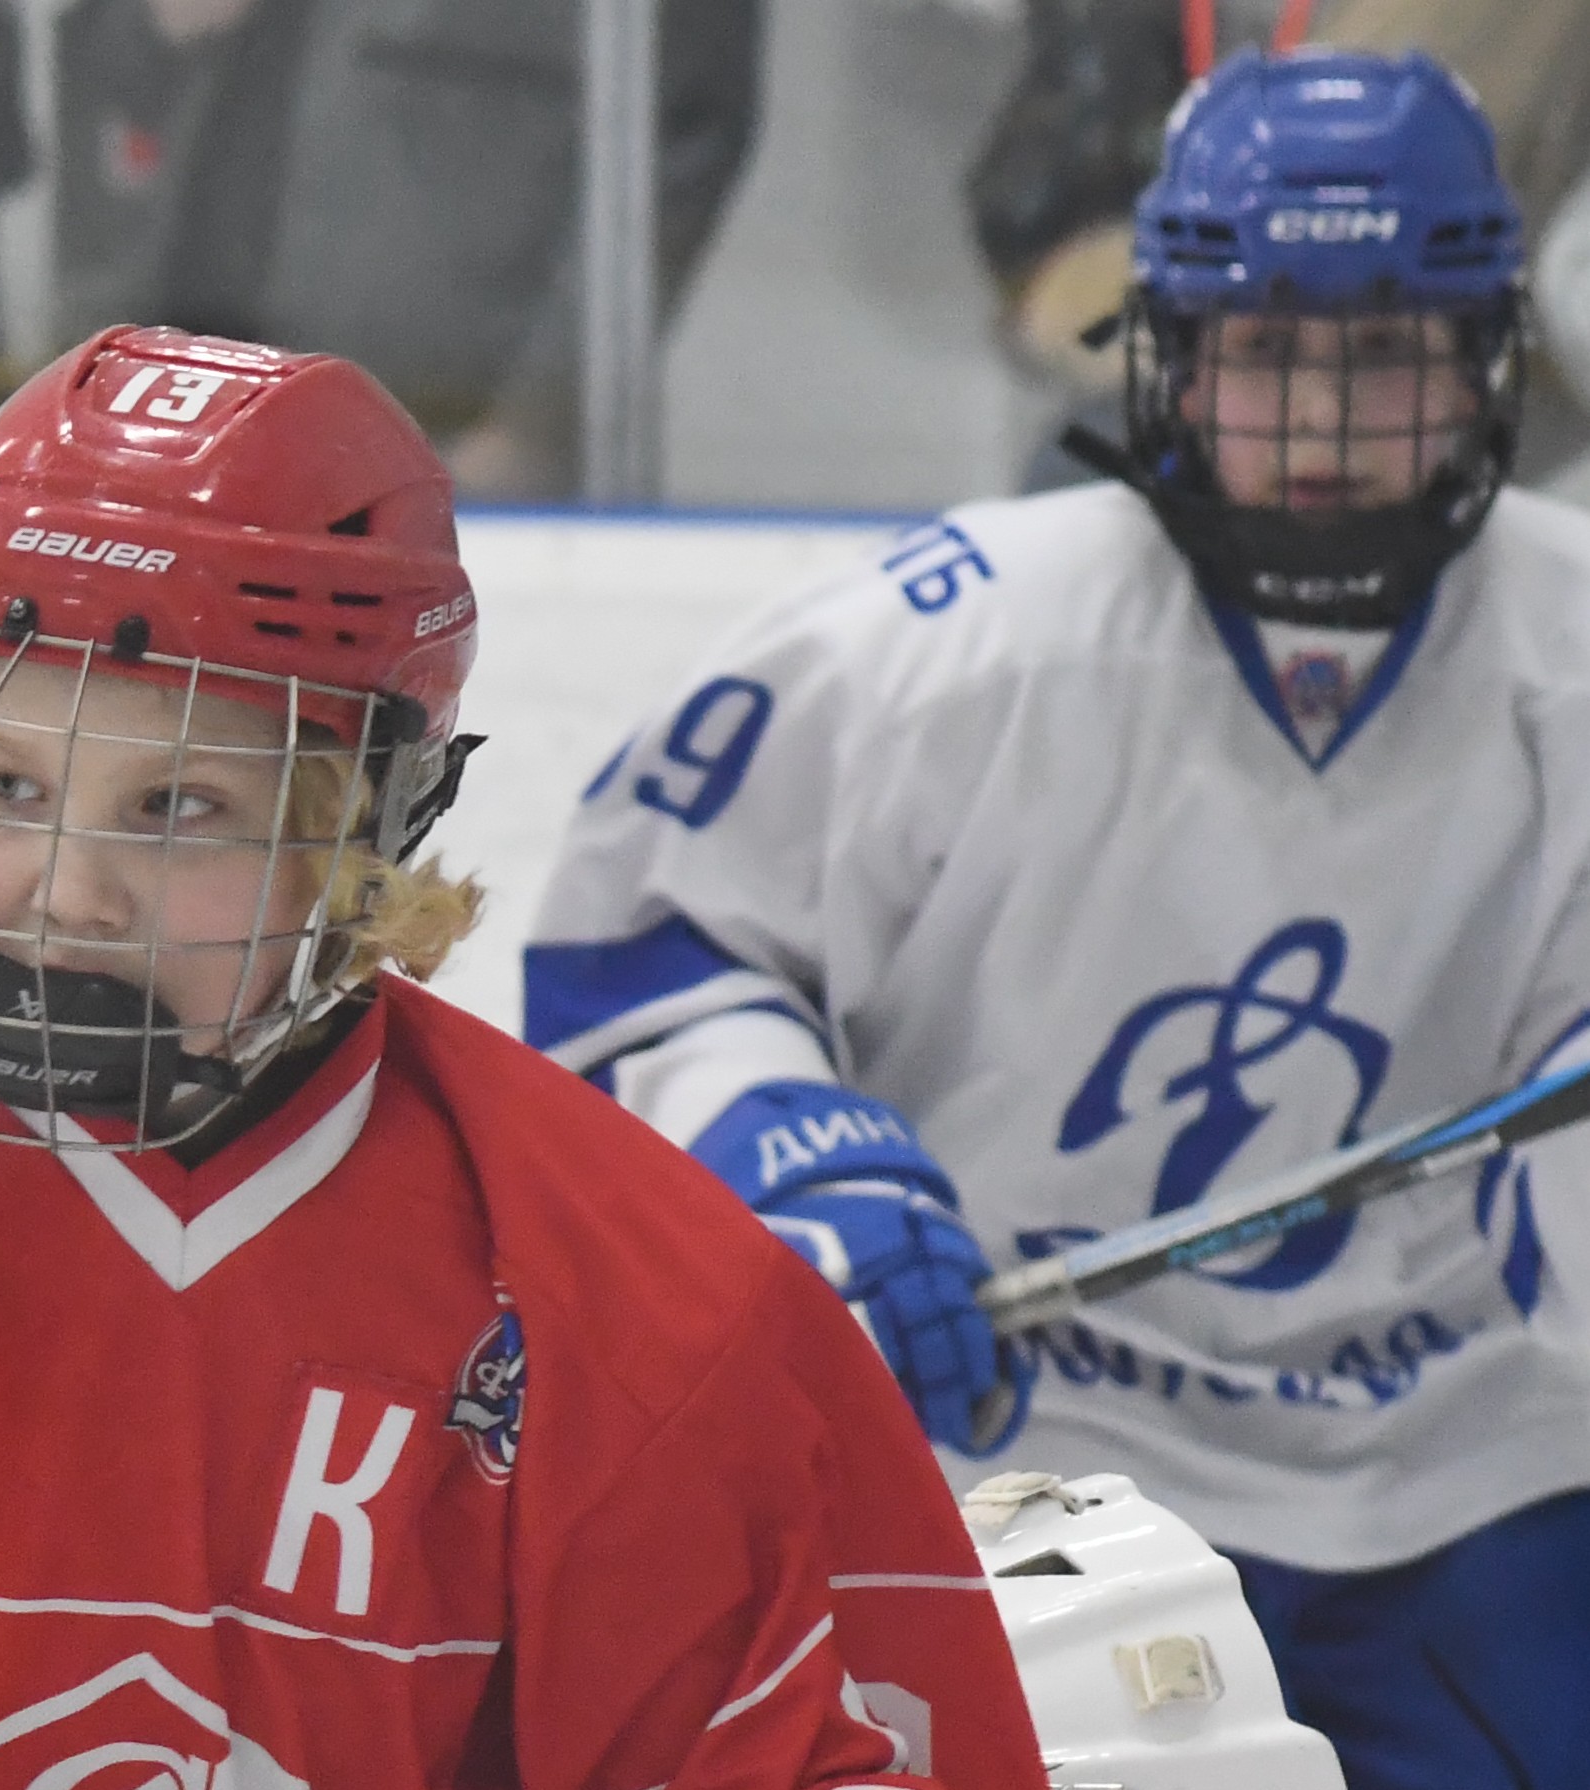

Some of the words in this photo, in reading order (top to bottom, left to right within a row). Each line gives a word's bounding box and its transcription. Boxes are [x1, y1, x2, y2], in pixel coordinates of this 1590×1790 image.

[108, 365, 222, 424] 13
[7, 526, 177, 573] BAUER
[881, 524, 995, 615] ТБ
